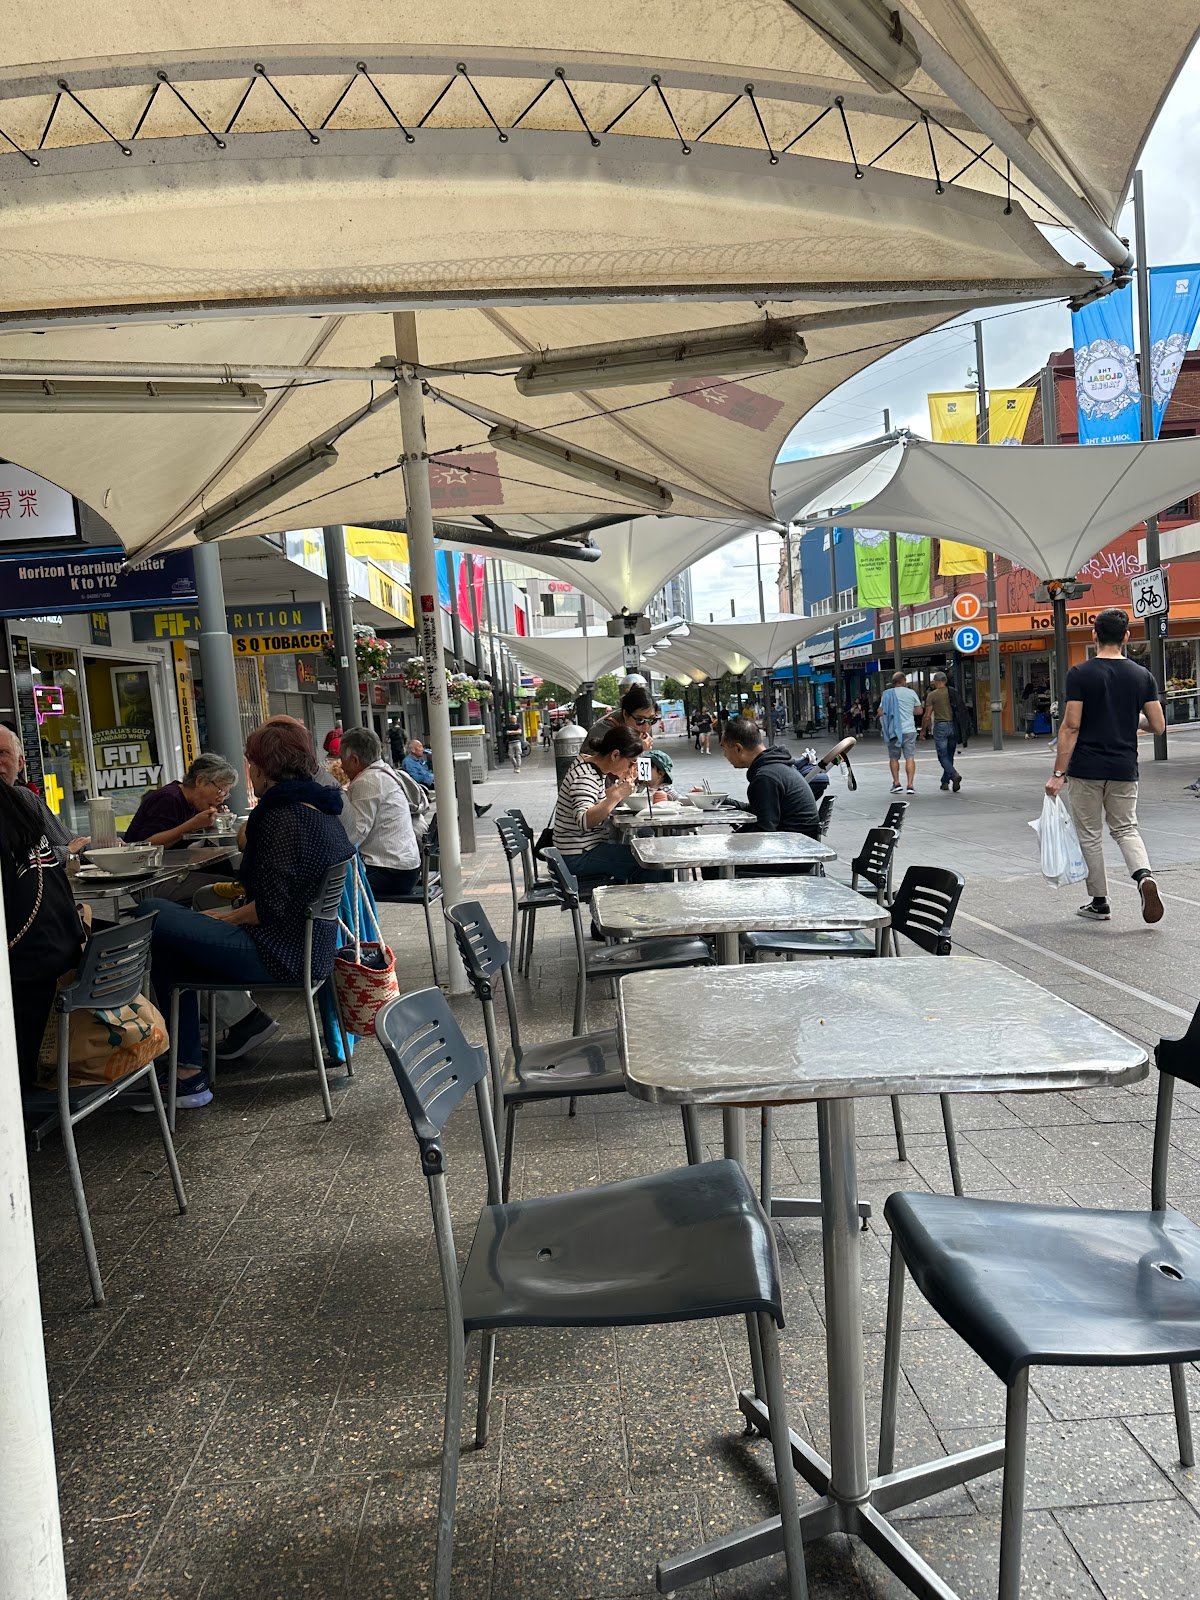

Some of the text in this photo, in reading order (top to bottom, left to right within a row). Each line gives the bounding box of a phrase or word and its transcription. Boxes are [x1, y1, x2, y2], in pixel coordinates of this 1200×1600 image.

[18, 557, 166, 580] Horizon Learning enter
[71, 575, 117, 590] K to Y12
[1133, 573, 1160, 587] WATCH FOR
[556, 583, 573, 593] HCF
[961, 600, 973, 615] T
[194, 610, 302, 631] NRITION
[236, 633, 334, 653] S Q TOBACCO
[934, 630, 944, 642] hot
[963, 632, 975, 648] B
[1000, 642, 1033, 652] dollar
[91, 727, 151, 740] USTRALIA'S GOLD
[181, 687, 195, 766] TOBACCON
[93, 733, 127, 745] STANDARD
[103, 745, 141, 766] FIT
[96, 765, 163, 790] WHEY
[640, 762, 650, 778] 37
